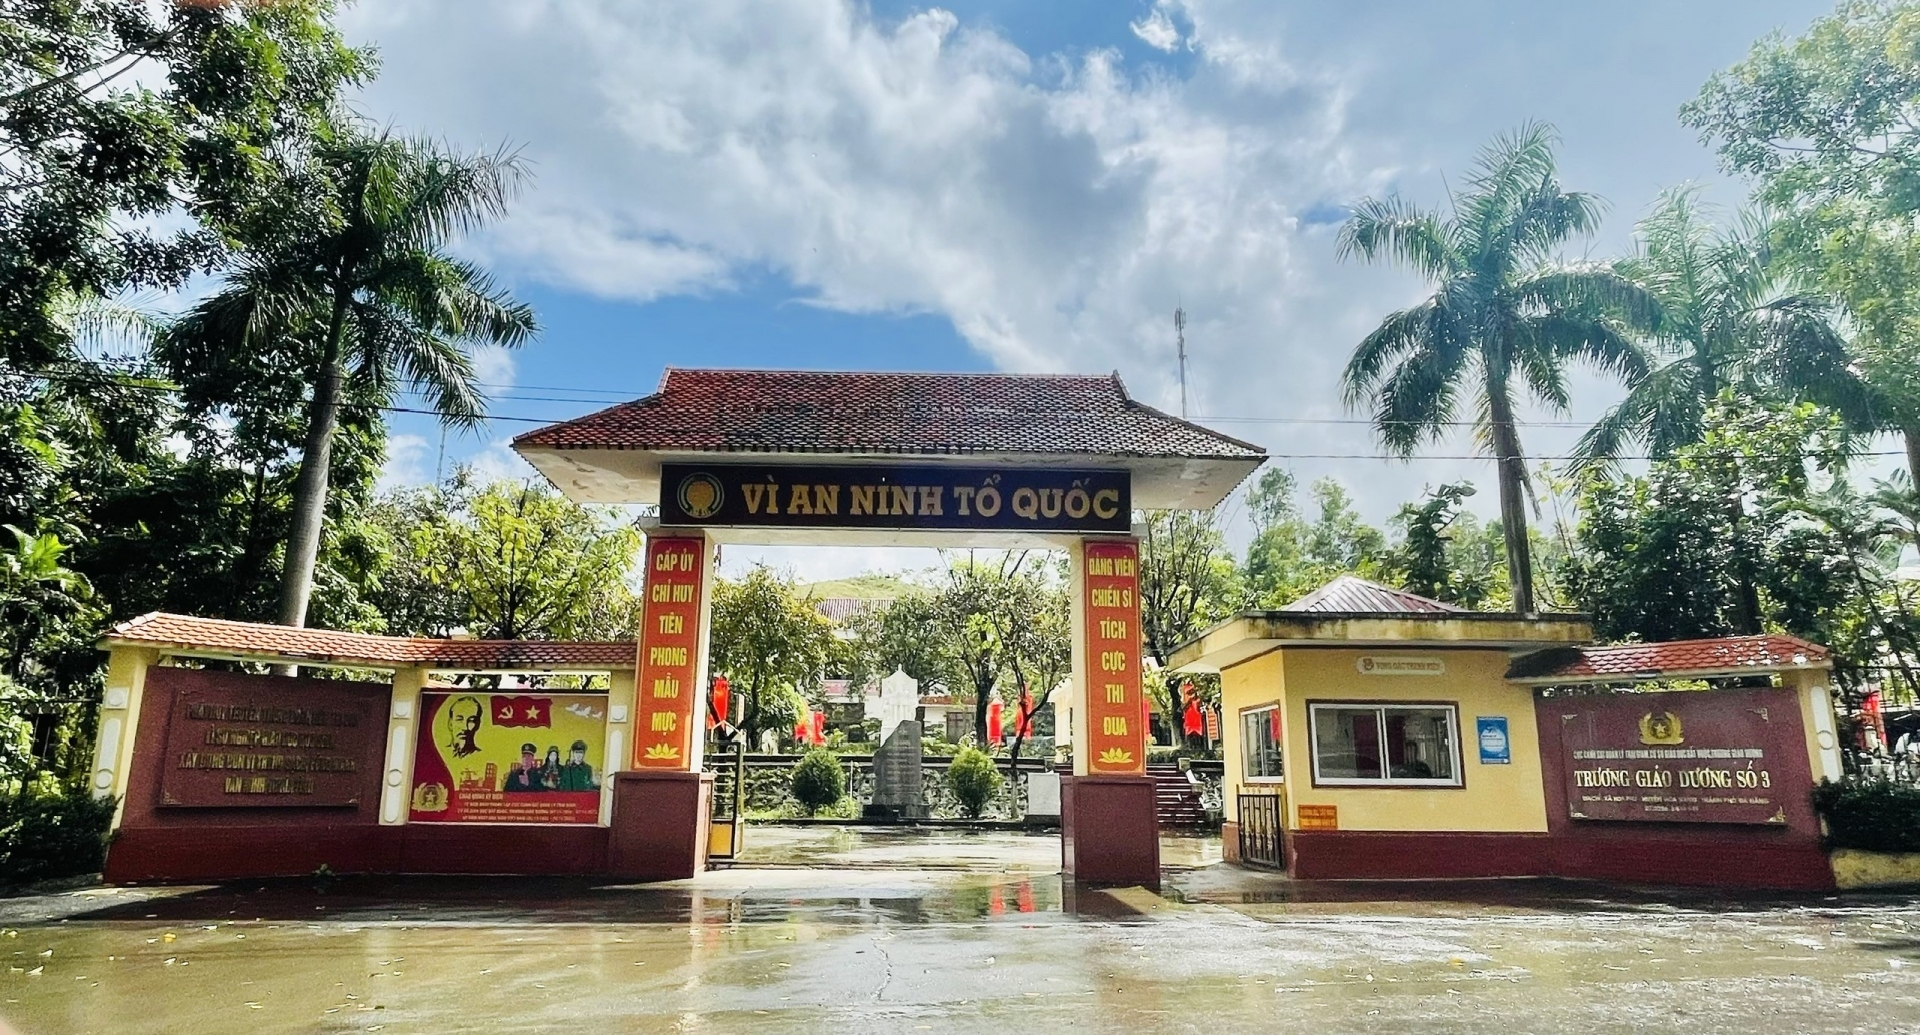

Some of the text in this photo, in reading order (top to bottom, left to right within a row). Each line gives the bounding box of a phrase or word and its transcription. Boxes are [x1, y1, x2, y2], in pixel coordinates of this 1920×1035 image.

[741, 473, 1119, 520] VÌ AN NINH TỔ QUỐC
[656, 547, 694, 571] CẤP ỦY
[1089, 552, 1135, 577] ĐẢNG VIÊN
[652, 579, 694, 603] CHỈ HUY
[1091, 584, 1132, 608] CHIẾN SĨ
[659, 612, 683, 634] TIÊN
[1100, 616, 1126, 639] TÍCH
[650, 646, 687, 666] PHONG
[1101, 650, 1126, 675] CỰC
[653, 672, 679, 699] MẪU
[1105, 684, 1124, 703] THI
[651, 711, 677, 736] MỰC
[1103, 716, 1128, 736] ĐUA
[1736, 760, 1758, 788] SỐ
[1760, 771, 1771, 788] 3
